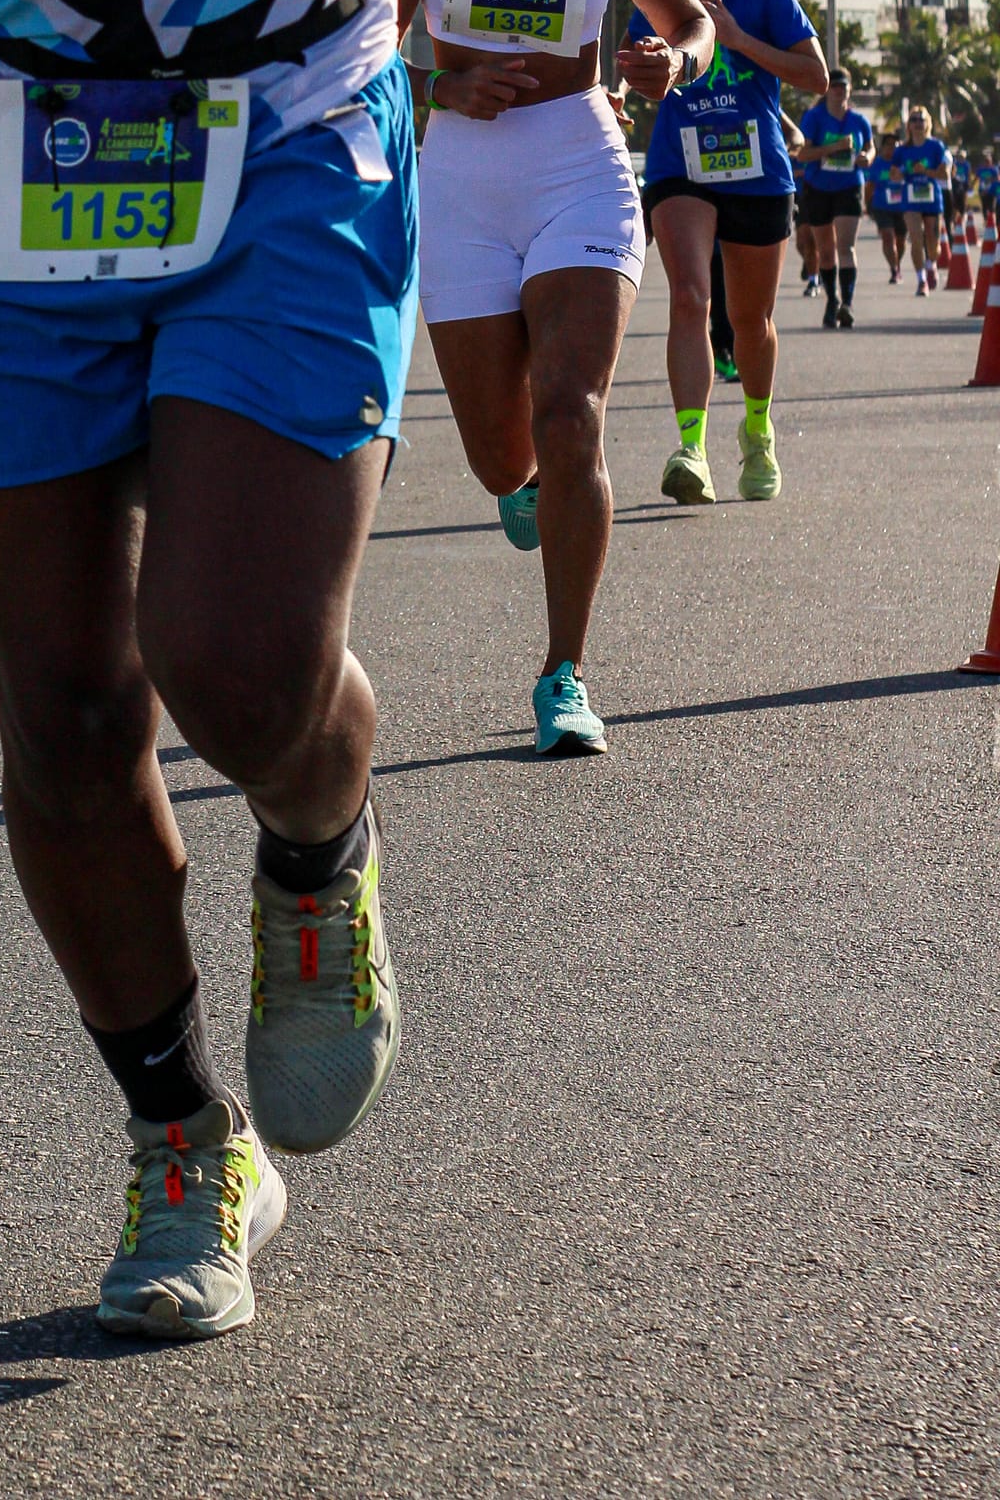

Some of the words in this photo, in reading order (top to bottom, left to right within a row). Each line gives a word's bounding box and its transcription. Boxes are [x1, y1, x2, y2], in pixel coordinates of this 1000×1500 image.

[484, 11, 552, 37] 1382
[699, 98, 713, 110] 5k
[713, 93, 737, 107] 10k
[208, 108, 229, 121] 5K
[708, 152, 747, 170] 2495
[50, 190, 176, 241] 1153
